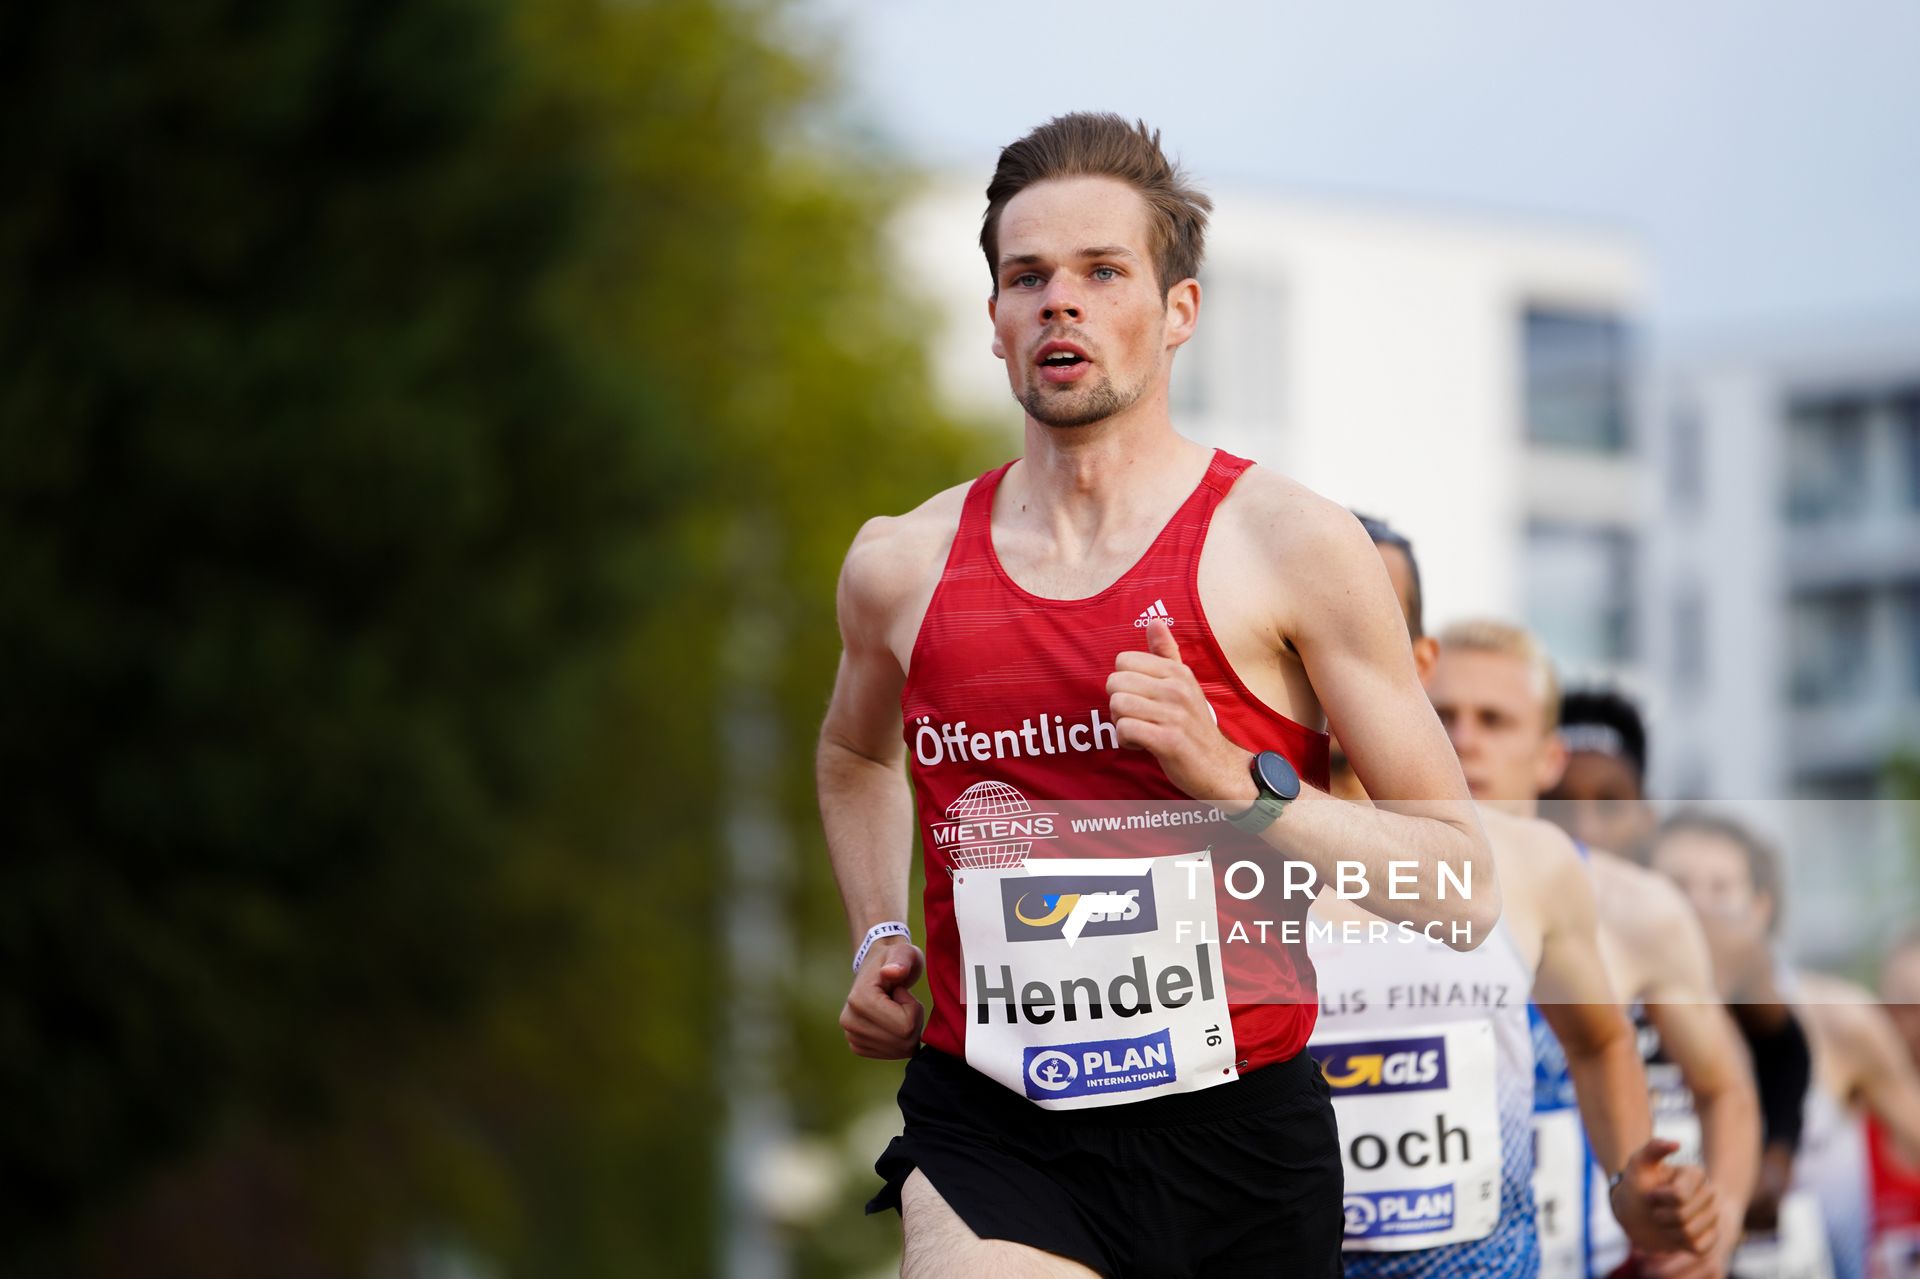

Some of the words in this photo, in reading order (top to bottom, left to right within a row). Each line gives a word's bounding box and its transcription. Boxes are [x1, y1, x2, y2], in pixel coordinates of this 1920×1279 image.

[1133, 616, 1174, 628] adas
[915, 709, 1120, 766] Öffentlich
[933, 817, 1054, 845] MIETENS
[973, 942, 1216, 1026] Hendel
[1321, 989, 1368, 1017] LIS
[1388, 982, 1511, 1010] FINANZ
[1204, 1024, 1222, 1047] 16
[1082, 1042, 1168, 1075] PLAN
[1382, 1049, 1440, 1086] GLS
[1086, 1069, 1170, 1088] INTERNATIONAL
[1349, 1112, 1471, 1172] och
[1378, 1192, 1452, 1222] PLAN
